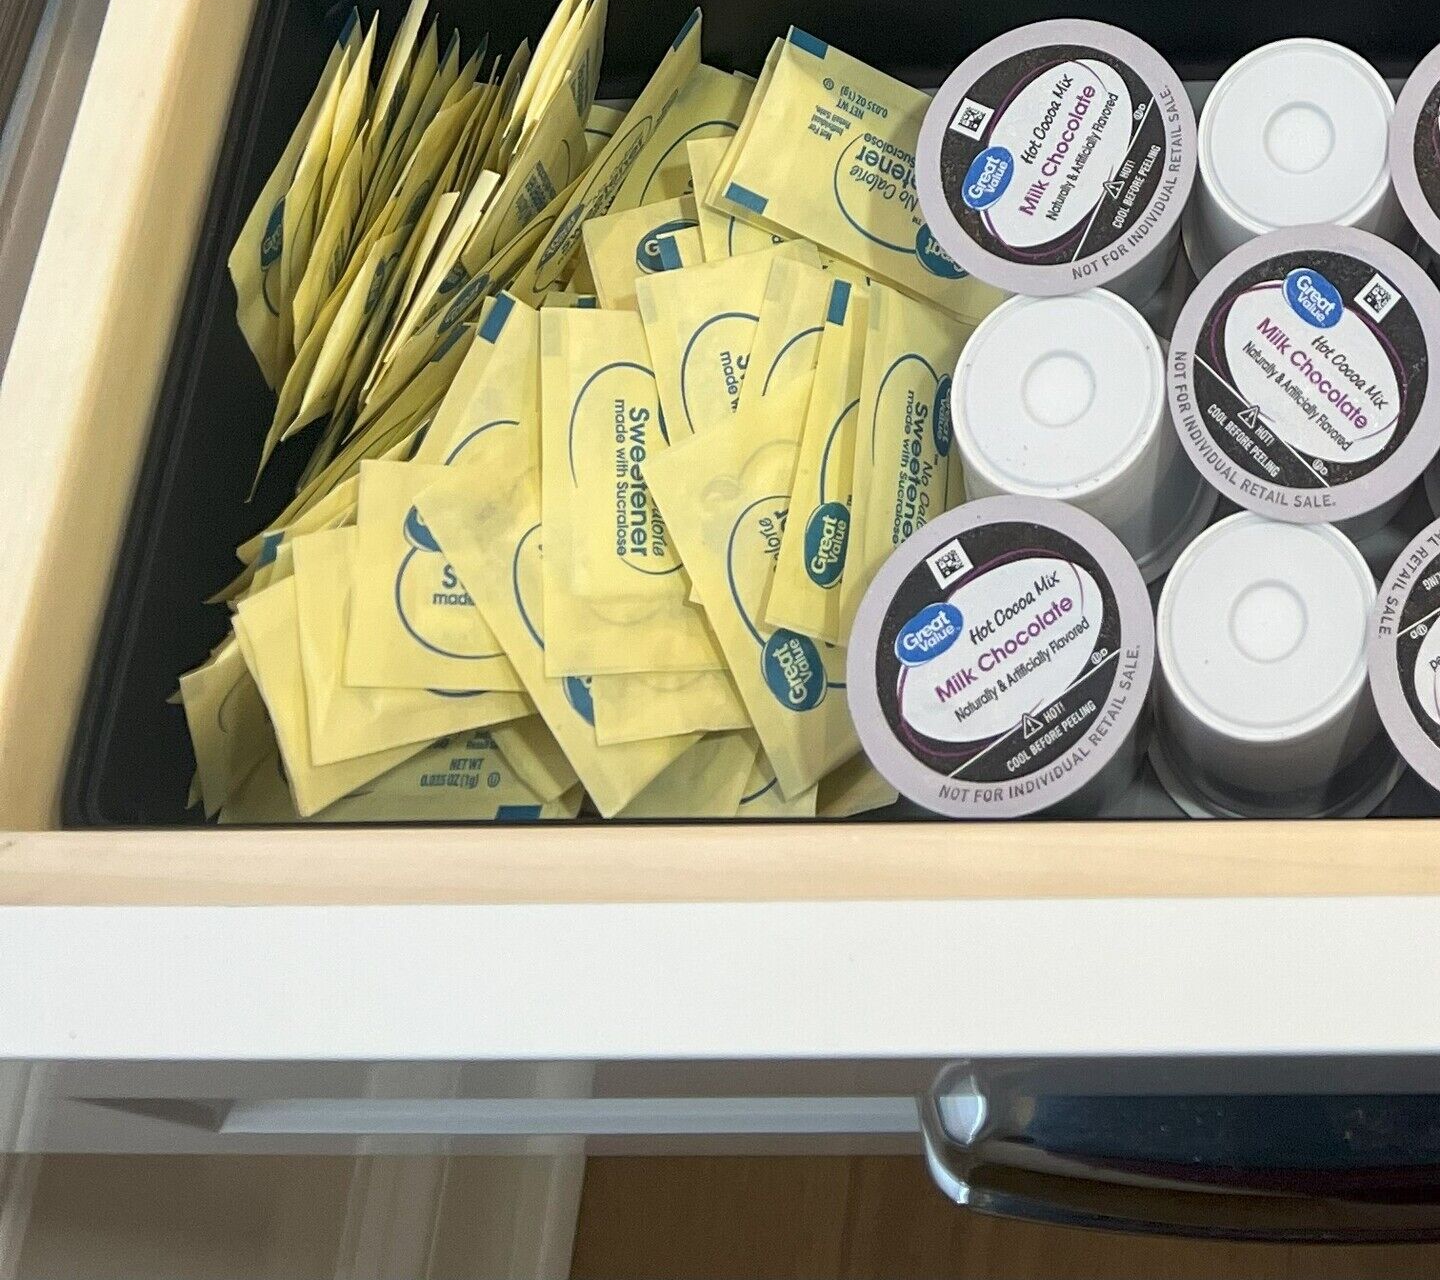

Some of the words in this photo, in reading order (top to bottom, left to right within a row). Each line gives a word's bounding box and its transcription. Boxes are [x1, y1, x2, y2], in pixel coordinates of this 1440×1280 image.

[1020, 139, 1043, 165] Hot
[1034, 100, 1062, 140] Cocoa
[1055, 74, 1074, 103] Mix
[968, 155, 1000, 200] Great
[986, 161, 1008, 194] Value
[1018, 180, 1050, 216] Milk
[1042, 85, 1096, 178] Chocolate
[1295, 274, 1336, 316] Great
[1297, 294, 1326, 323] Value
[1256, 317, 1292, 355] Milk
[1290, 350, 1369, 430] Chocolate
[1310, 335, 1336, 360] Hot
[1330, 353, 1366, 391] Cocoa
[1364, 382, 1390, 411] Mix
[615, 399, 625, 443] made
[616, 446, 626, 477] with
[616, 481, 627, 557] Sucralose
[903, 610, 952, 650] Great
[969, 621, 996, 646] Hot
[993, 594, 1037, 627] Cocoa
[1033, 571, 1061, 598] Mix
[790, 638, 813, 684] Value
[917, 625, 955, 653] Value
[934, 668, 979, 703] Milk
[977, 597, 1074, 673] Chocolate
[772, 642, 808, 704] Great
[938, 785, 971, 802] NOT
[974, 787, 1004, 803] FOR
[1008, 747, 1091, 800] INDIVIDUAL
[1088, 695, 1128, 747] RETAIL
